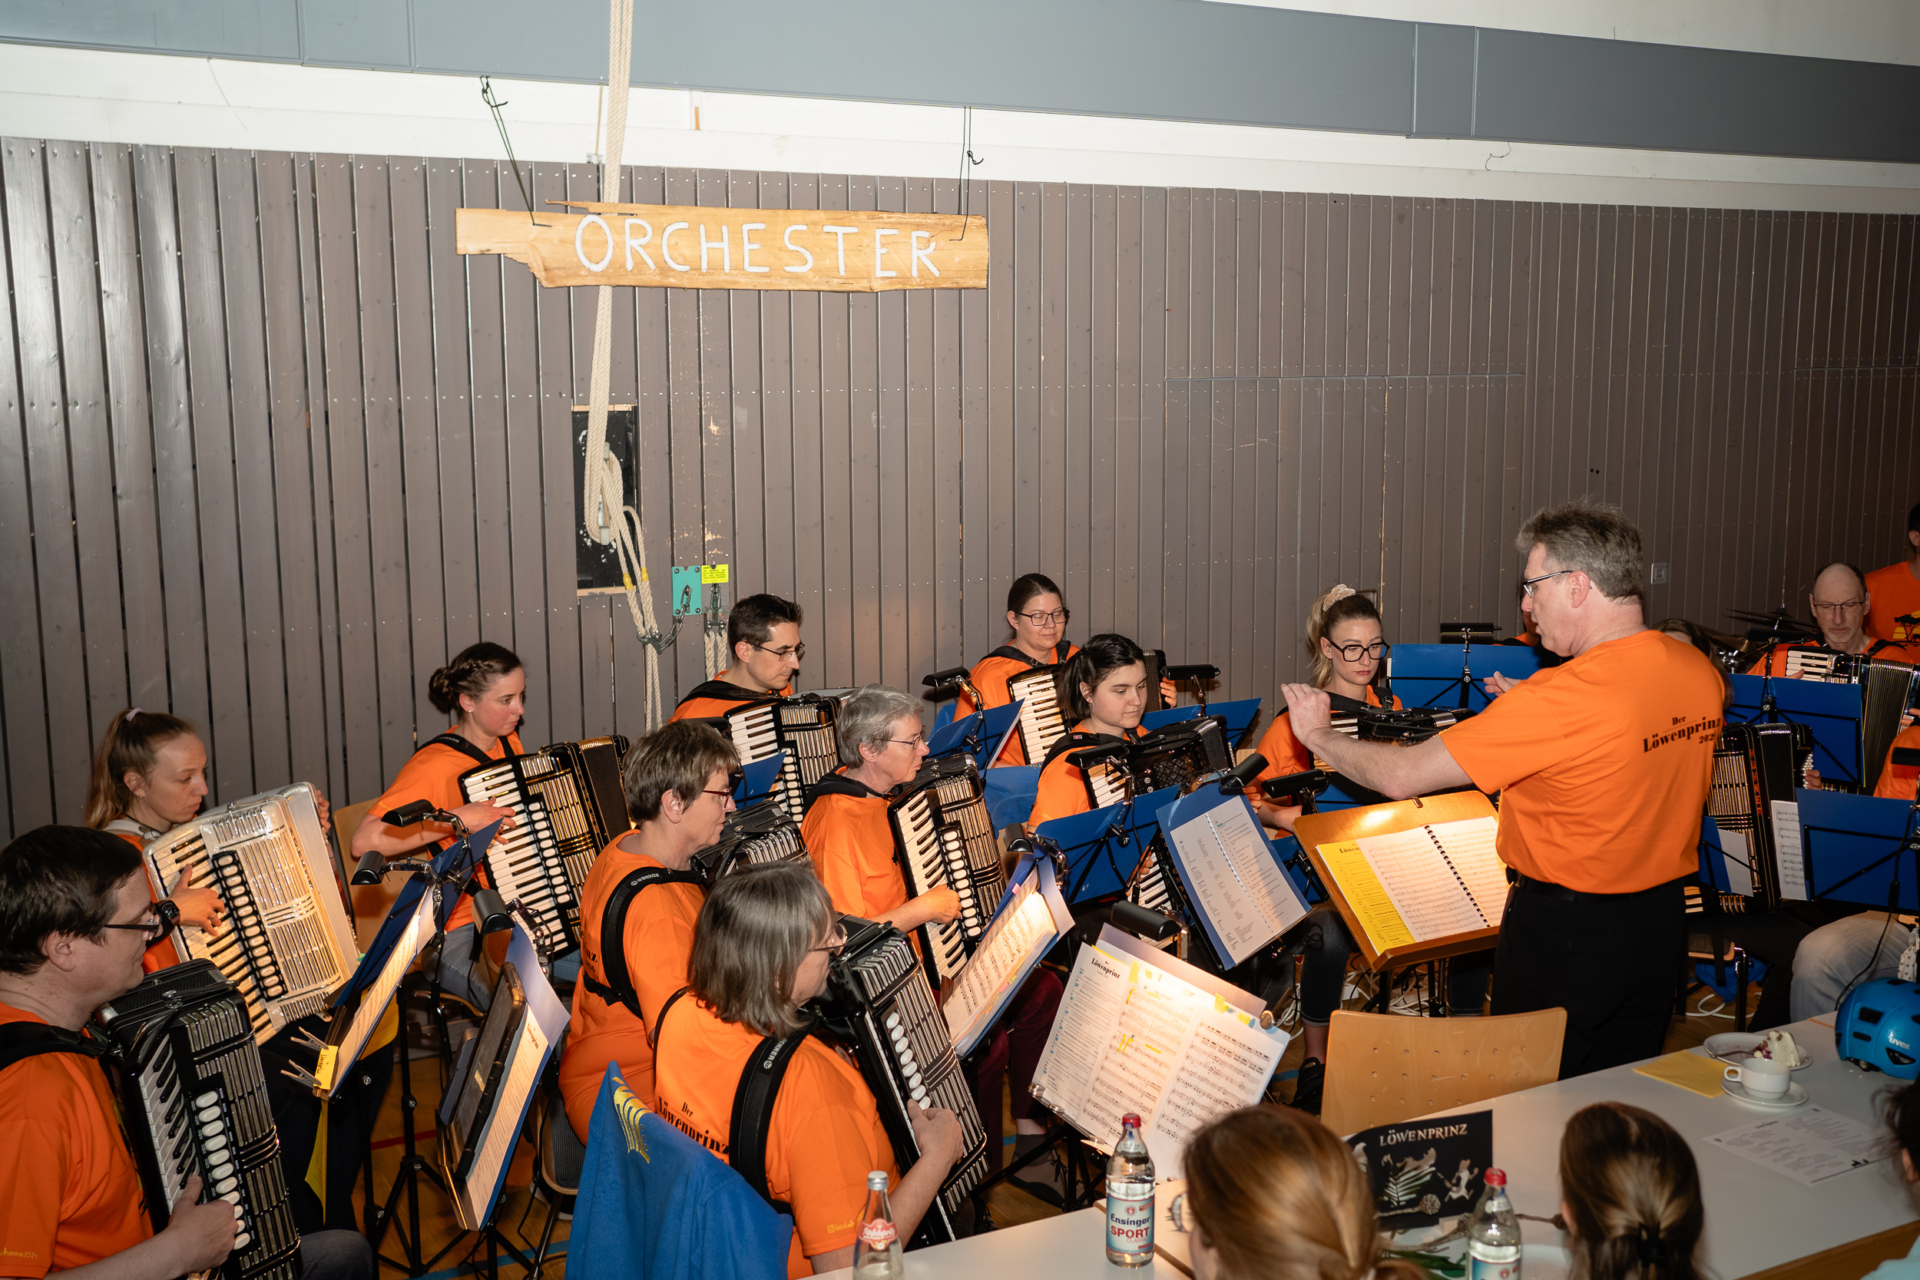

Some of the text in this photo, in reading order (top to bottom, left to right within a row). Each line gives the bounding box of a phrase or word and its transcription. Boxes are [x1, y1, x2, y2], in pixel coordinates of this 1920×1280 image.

[574, 214, 941, 278] ORCHESTER
[1672, 716, 1686, 726] Der
[1643, 716, 1721, 753] Löwenprinz
[681, 1101, 694, 1117] Der
[1379, 1123, 1468, 1147] LÖWENPRINZ
[1110, 1212, 1151, 1228] Ensinger
[1110, 1225, 1150, 1239] SPORT
